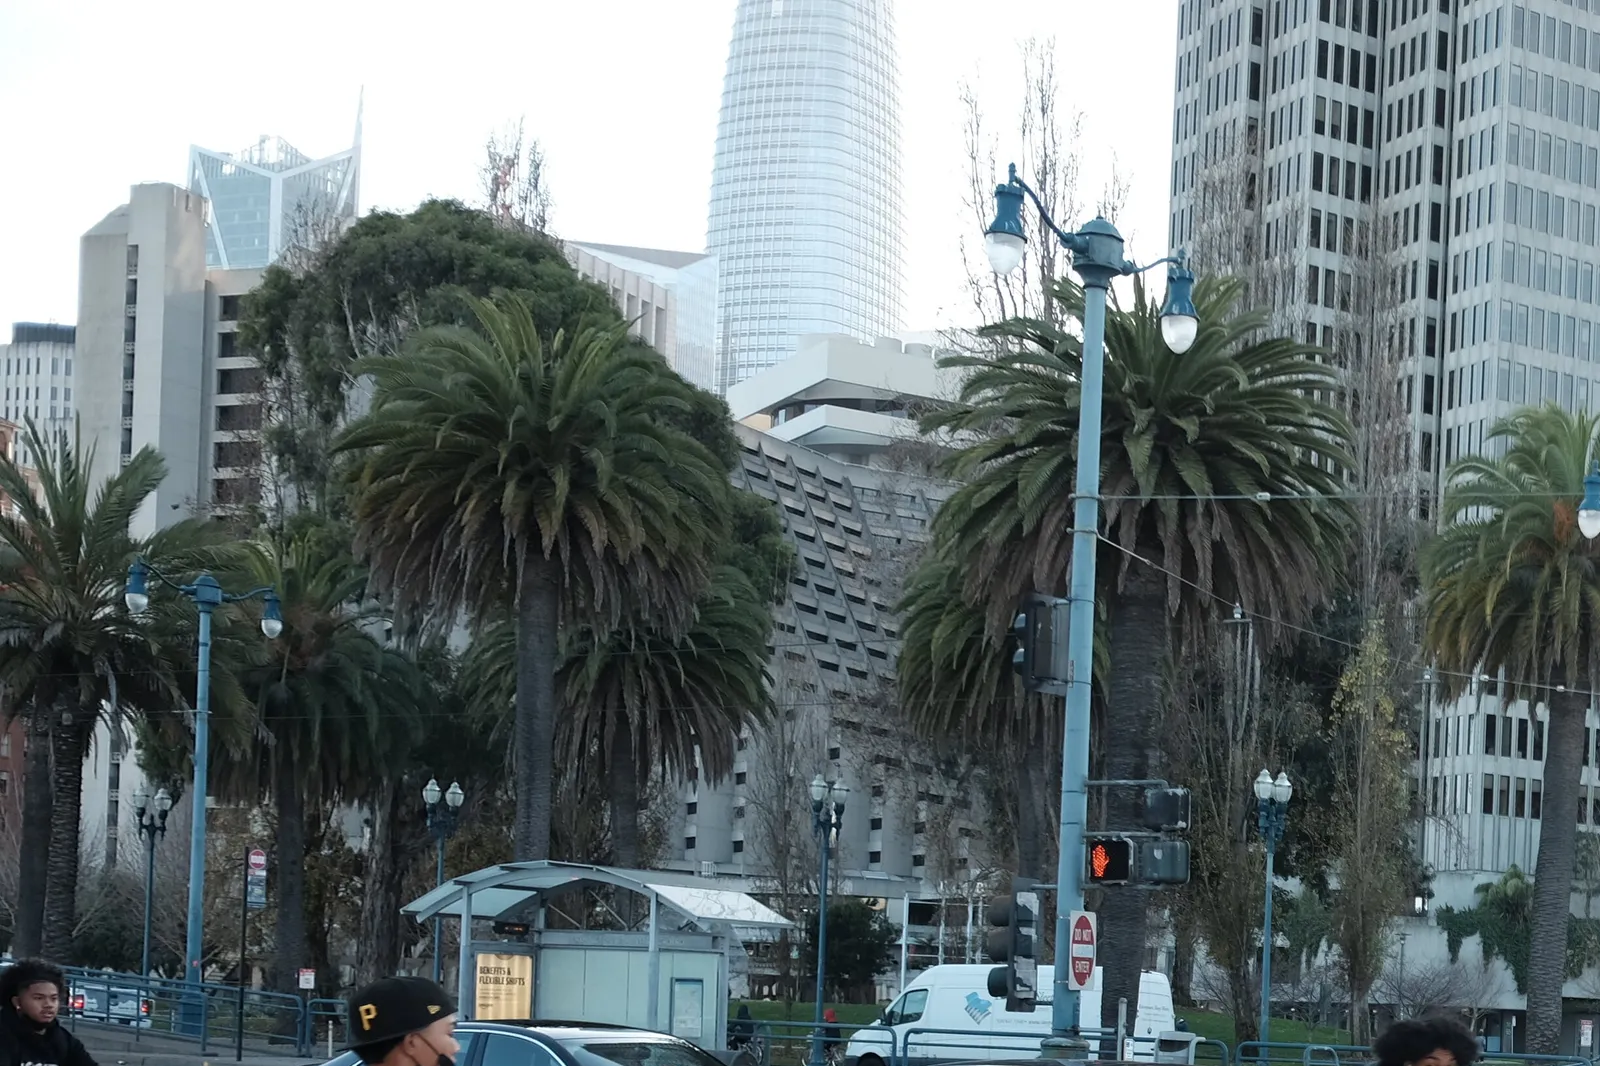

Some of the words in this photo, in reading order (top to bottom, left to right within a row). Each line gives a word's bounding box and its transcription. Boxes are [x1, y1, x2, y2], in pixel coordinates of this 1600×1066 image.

[1083, 929, 1091, 941] NOT
[480, 966, 506, 975] BENEFITS
[1075, 961, 1090, 973] ENTER
[479, 976, 505, 985] FLEXIBLE
[359, 1004, 377, 1031] P
